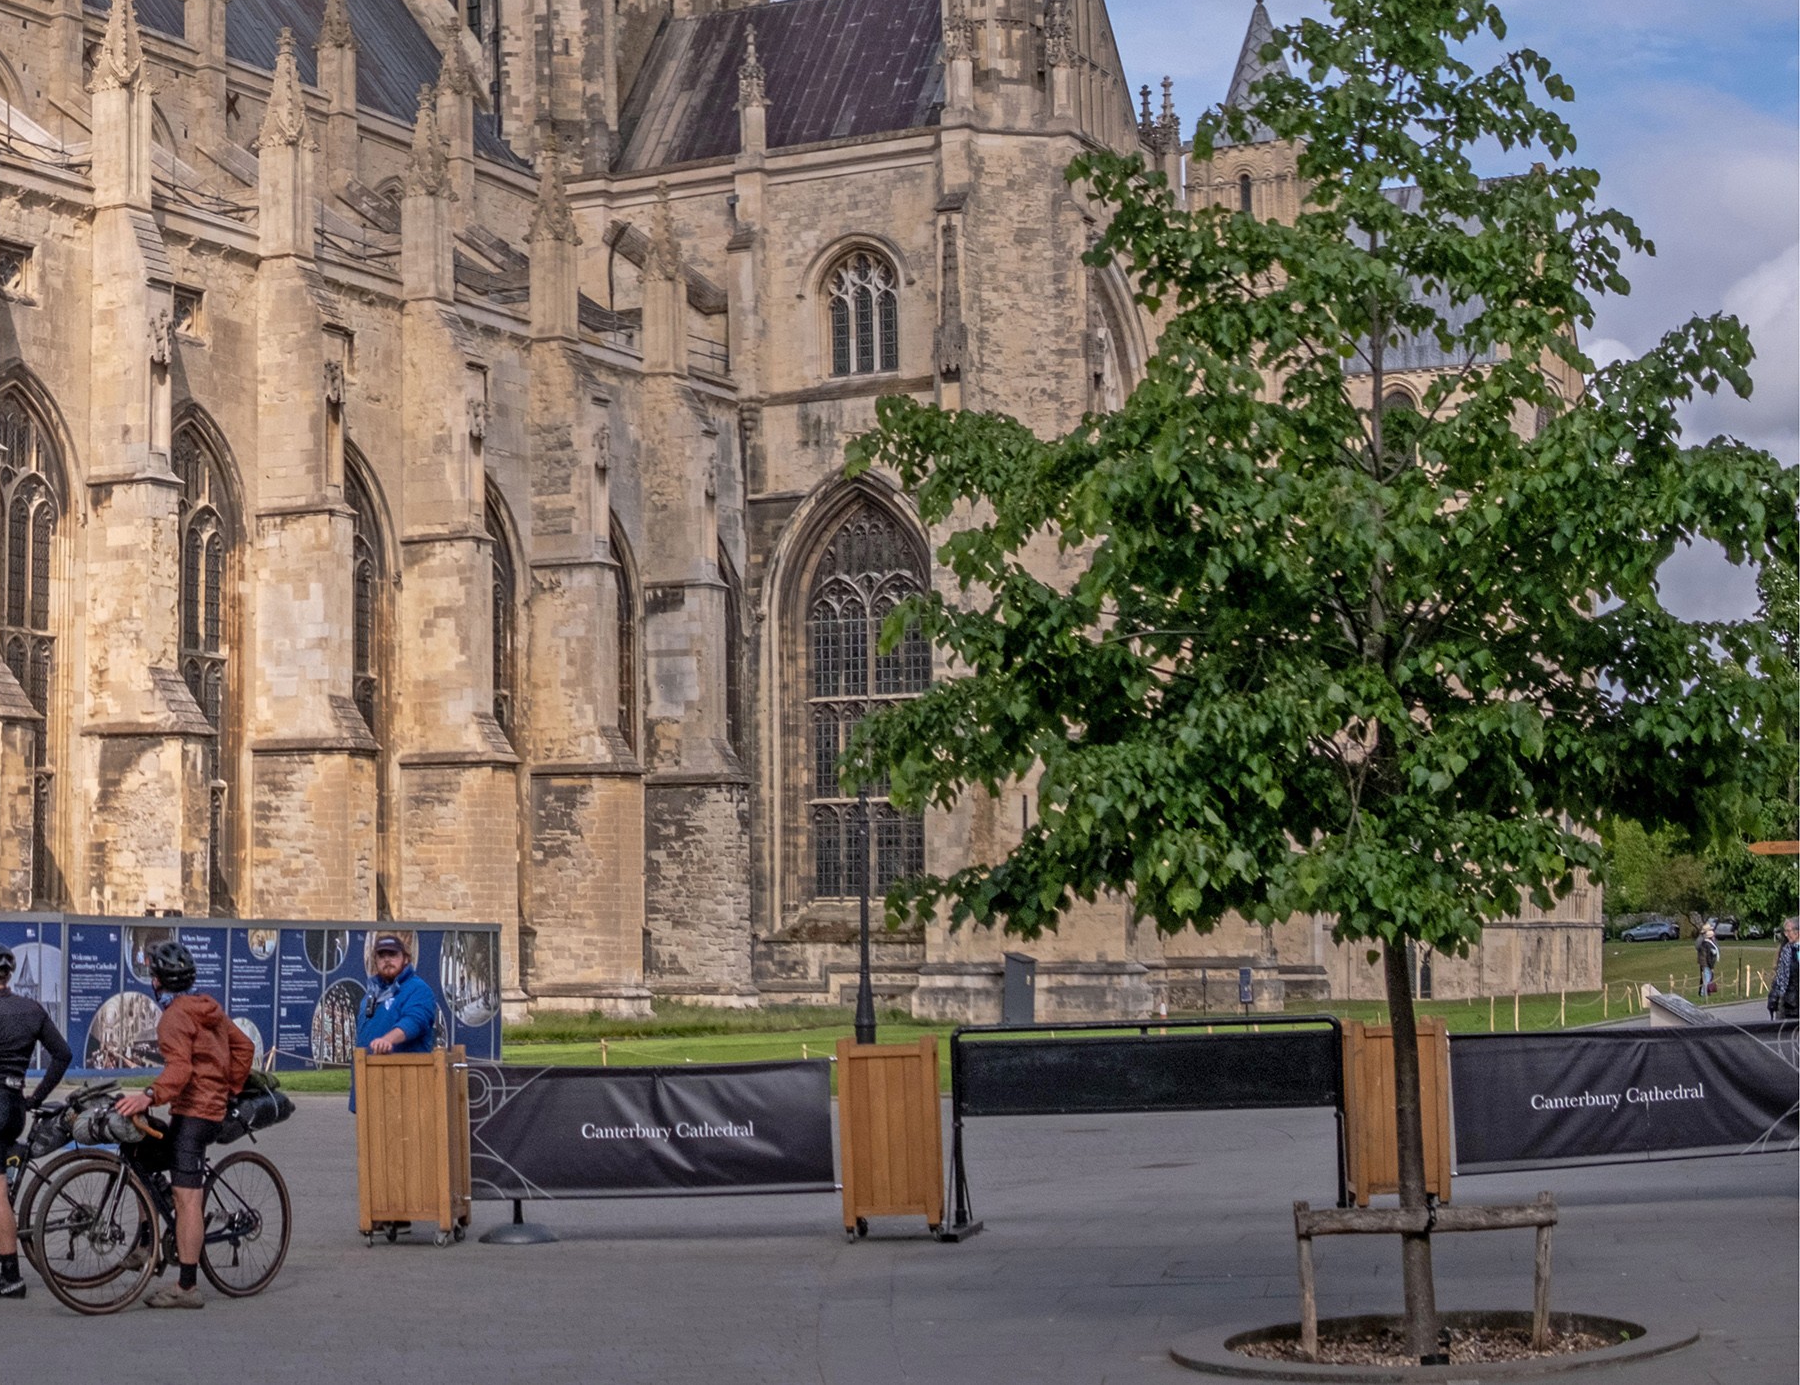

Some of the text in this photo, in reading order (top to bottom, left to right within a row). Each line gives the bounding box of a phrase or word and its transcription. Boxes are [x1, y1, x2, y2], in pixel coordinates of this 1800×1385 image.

[71, 953, 92, 961] Welcome
[71, 961, 117, 971] Canterbury Cathedral
[1531, 1082, 1705, 1111] Canterbury Cathedral
[581, 1120, 755, 1143] Canterbury Cathedral
